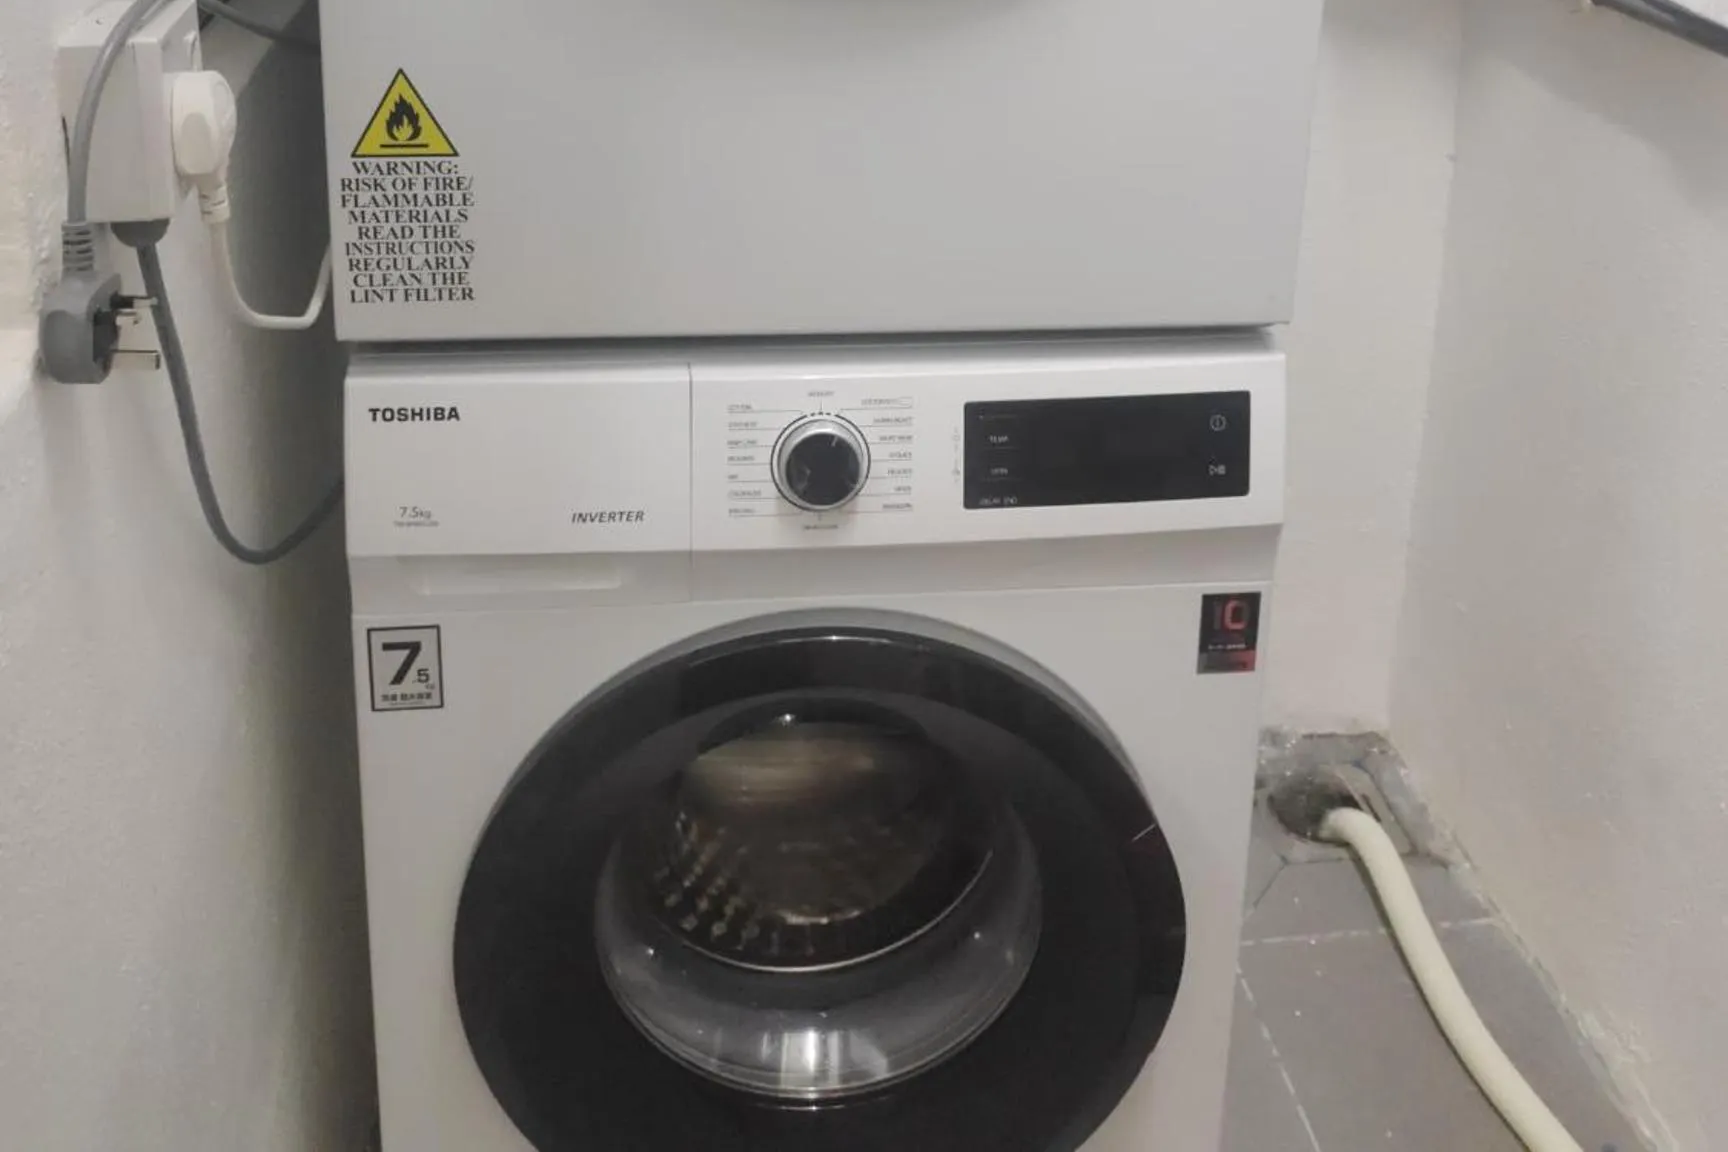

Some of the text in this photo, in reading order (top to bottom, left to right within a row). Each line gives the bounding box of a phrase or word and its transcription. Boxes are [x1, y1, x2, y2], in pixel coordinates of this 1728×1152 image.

[352, 160, 459, 176] WARNING:
[340, 177, 387, 192] RISK
[391, 177, 418, 192] OF
[340, 193, 475, 208] FLAMMABLE
[348, 209, 469, 224] MATERIALS
[357, 224, 461, 240] READ THE
[345, 240, 476, 256] INSTRUCTIONS
[348, 256, 474, 272] REGULARLY
[353, 272, 470, 287] CLEAN THE
[350, 287, 476, 303] LINT FILTER
[368, 406, 461, 422] TOSHIBA
[571, 510, 645, 524] INVERTER
